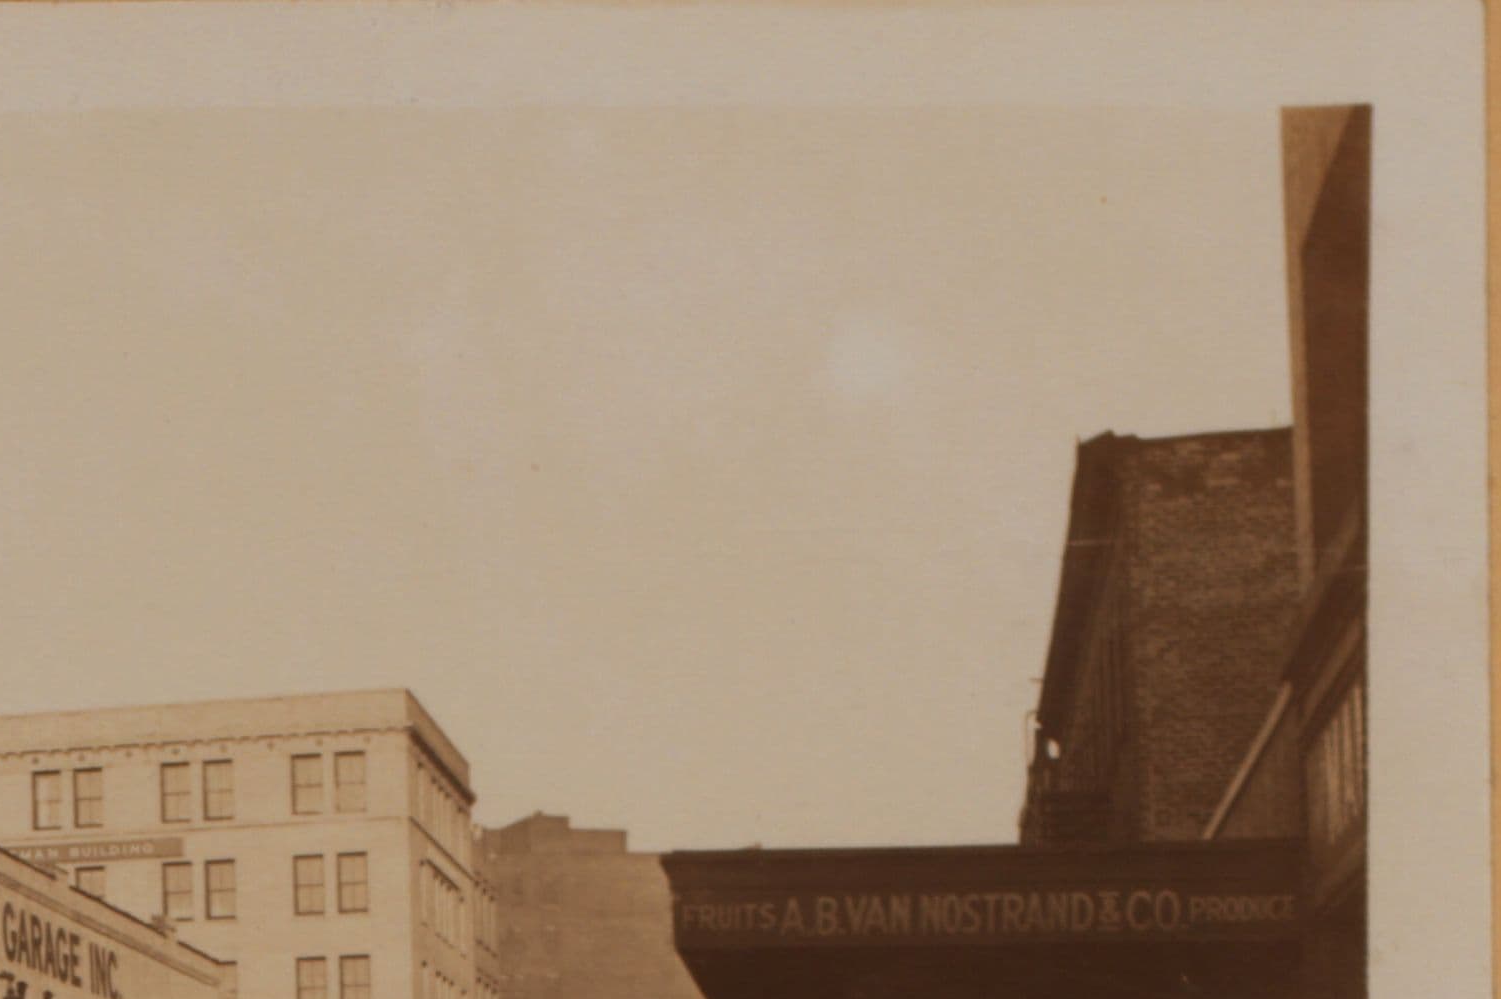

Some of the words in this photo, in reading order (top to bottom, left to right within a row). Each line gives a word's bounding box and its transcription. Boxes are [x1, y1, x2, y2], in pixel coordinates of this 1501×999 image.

[69, 842, 155, 858] BUILDING
[682, 903, 777, 931] FRUITS
[845, 894, 912, 934] VAN
[921, 891, 1095, 934] NOSTRAND
[2, 901, 83, 989] GARAGE
